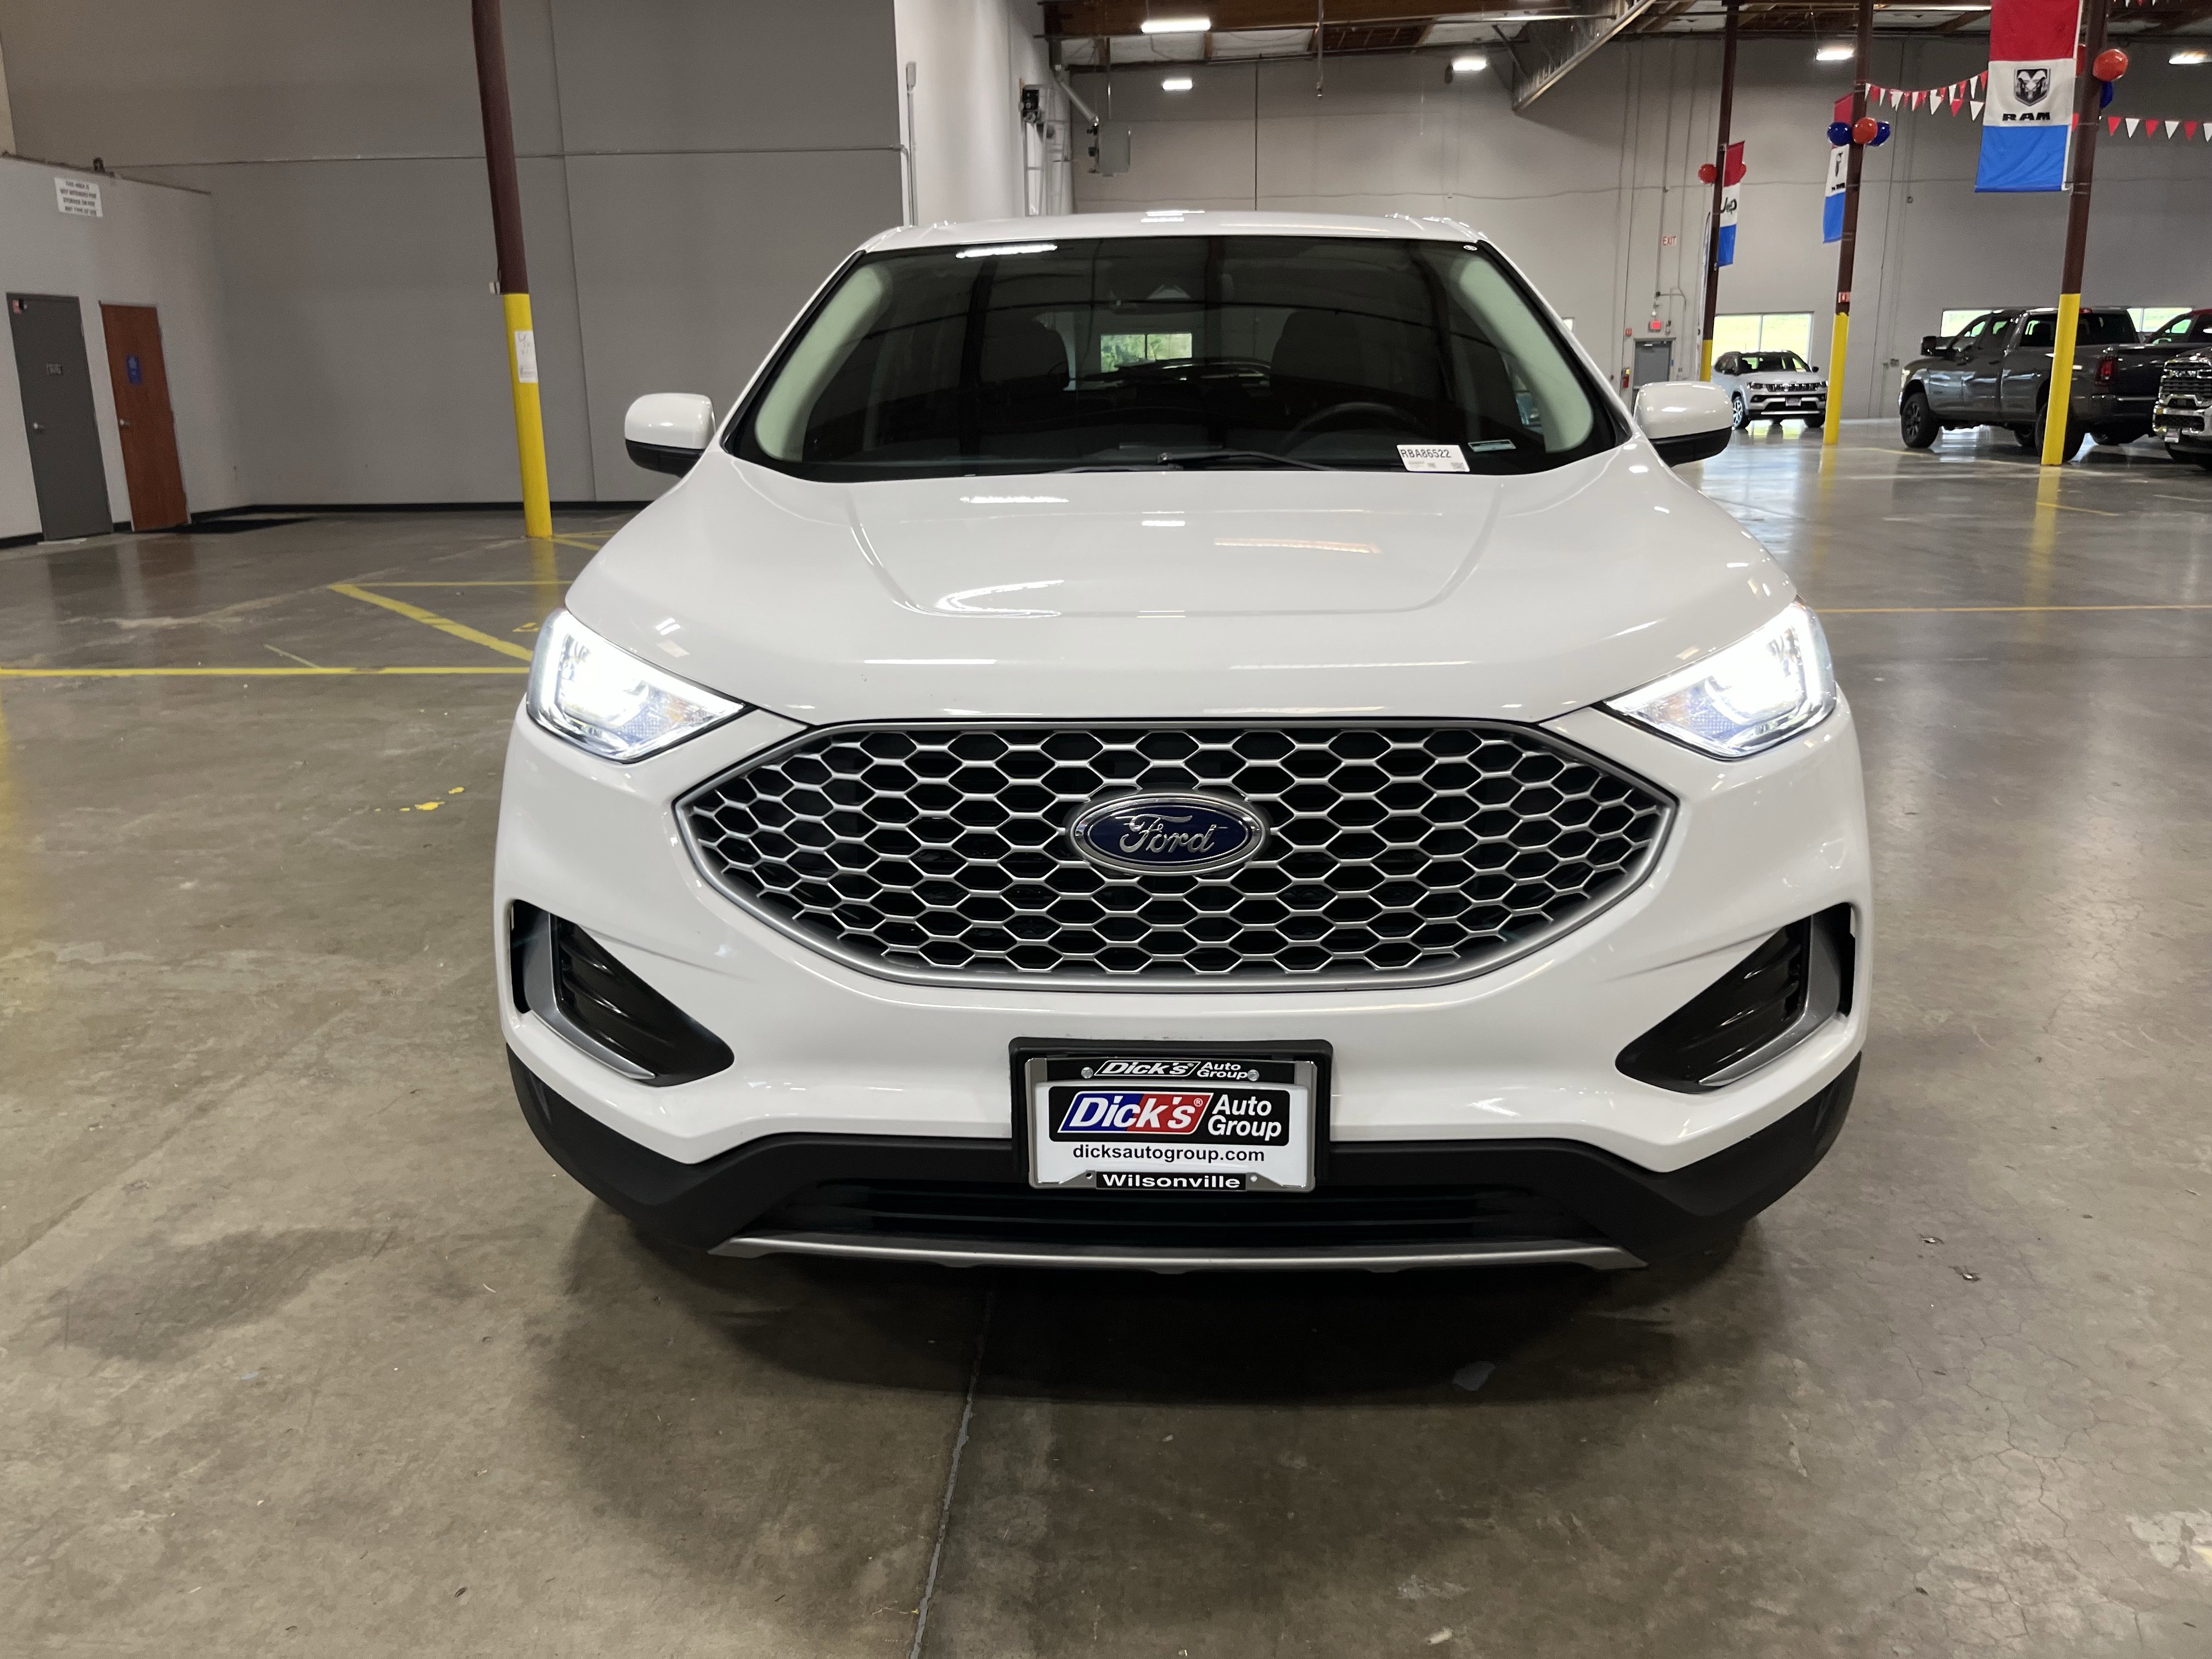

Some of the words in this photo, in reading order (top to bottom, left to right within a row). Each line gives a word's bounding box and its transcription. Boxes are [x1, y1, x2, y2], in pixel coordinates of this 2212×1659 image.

[2002, 112, 2050, 121] RAM
[1662, 236, 1676, 246] EXIT
[1400, 449, 1452, 458] RBA86522
[1116, 814, 1224, 853] Ford
[1101, 1062, 1189, 1075] Dick's
[1200, 1062, 1241, 1070] Auto
[1197, 1070, 1248, 1080] Group
[1212, 1094, 1272, 1116] Auto
[1068, 1096, 1195, 1129] Dick's
[1207, 1115, 1283, 1141] Group
[1073, 1144, 1265, 1163] dicksautogroup.com
[1102, 1173, 1240, 1188] Wilsonville
